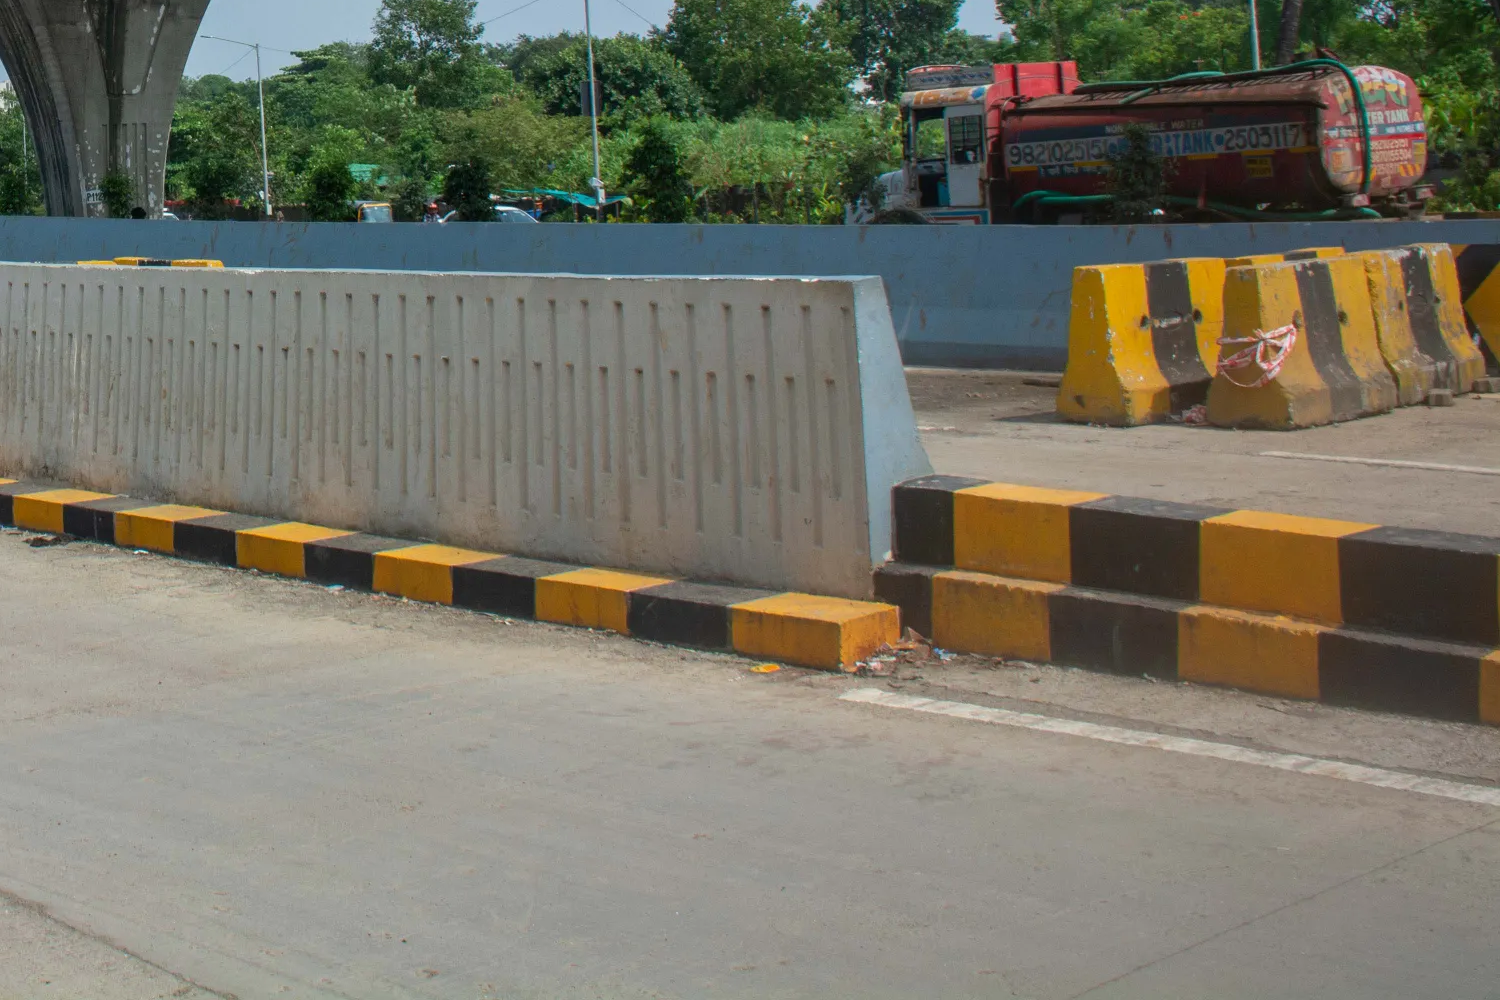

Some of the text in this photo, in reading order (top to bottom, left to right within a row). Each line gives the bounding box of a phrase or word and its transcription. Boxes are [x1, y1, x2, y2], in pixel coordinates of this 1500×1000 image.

[1386, 108, 1410, 123] TANK
[1171, 118, 1204, 130] WATER
[1173, 131, 1215, 156] TANK
